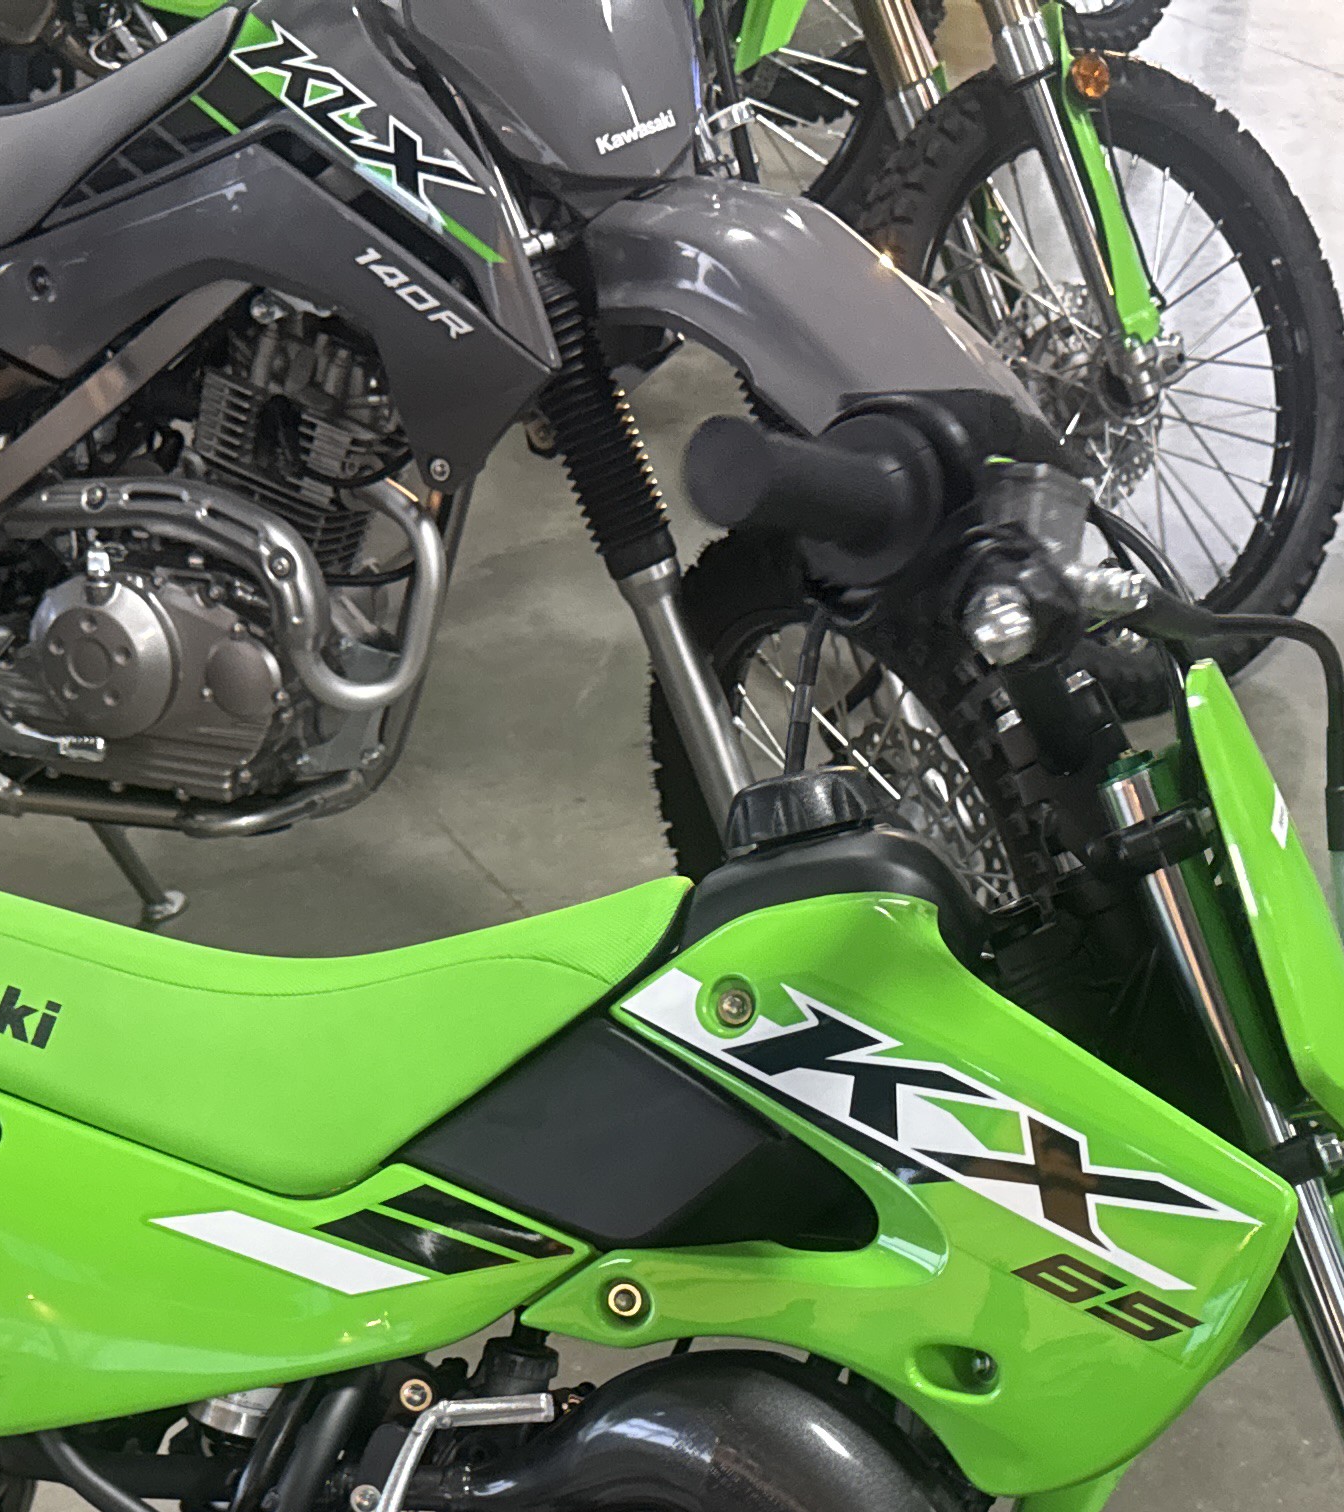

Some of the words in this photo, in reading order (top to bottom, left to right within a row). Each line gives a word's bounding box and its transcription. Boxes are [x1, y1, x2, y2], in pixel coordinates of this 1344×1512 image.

[230, 20, 486, 228] KLX
[595, 110, 676, 155] Kawasaki
[354, 247, 474, 339] 140R
[720, 998, 1236, 1260] KX
[1011, 1253, 1204, 1342] 65
